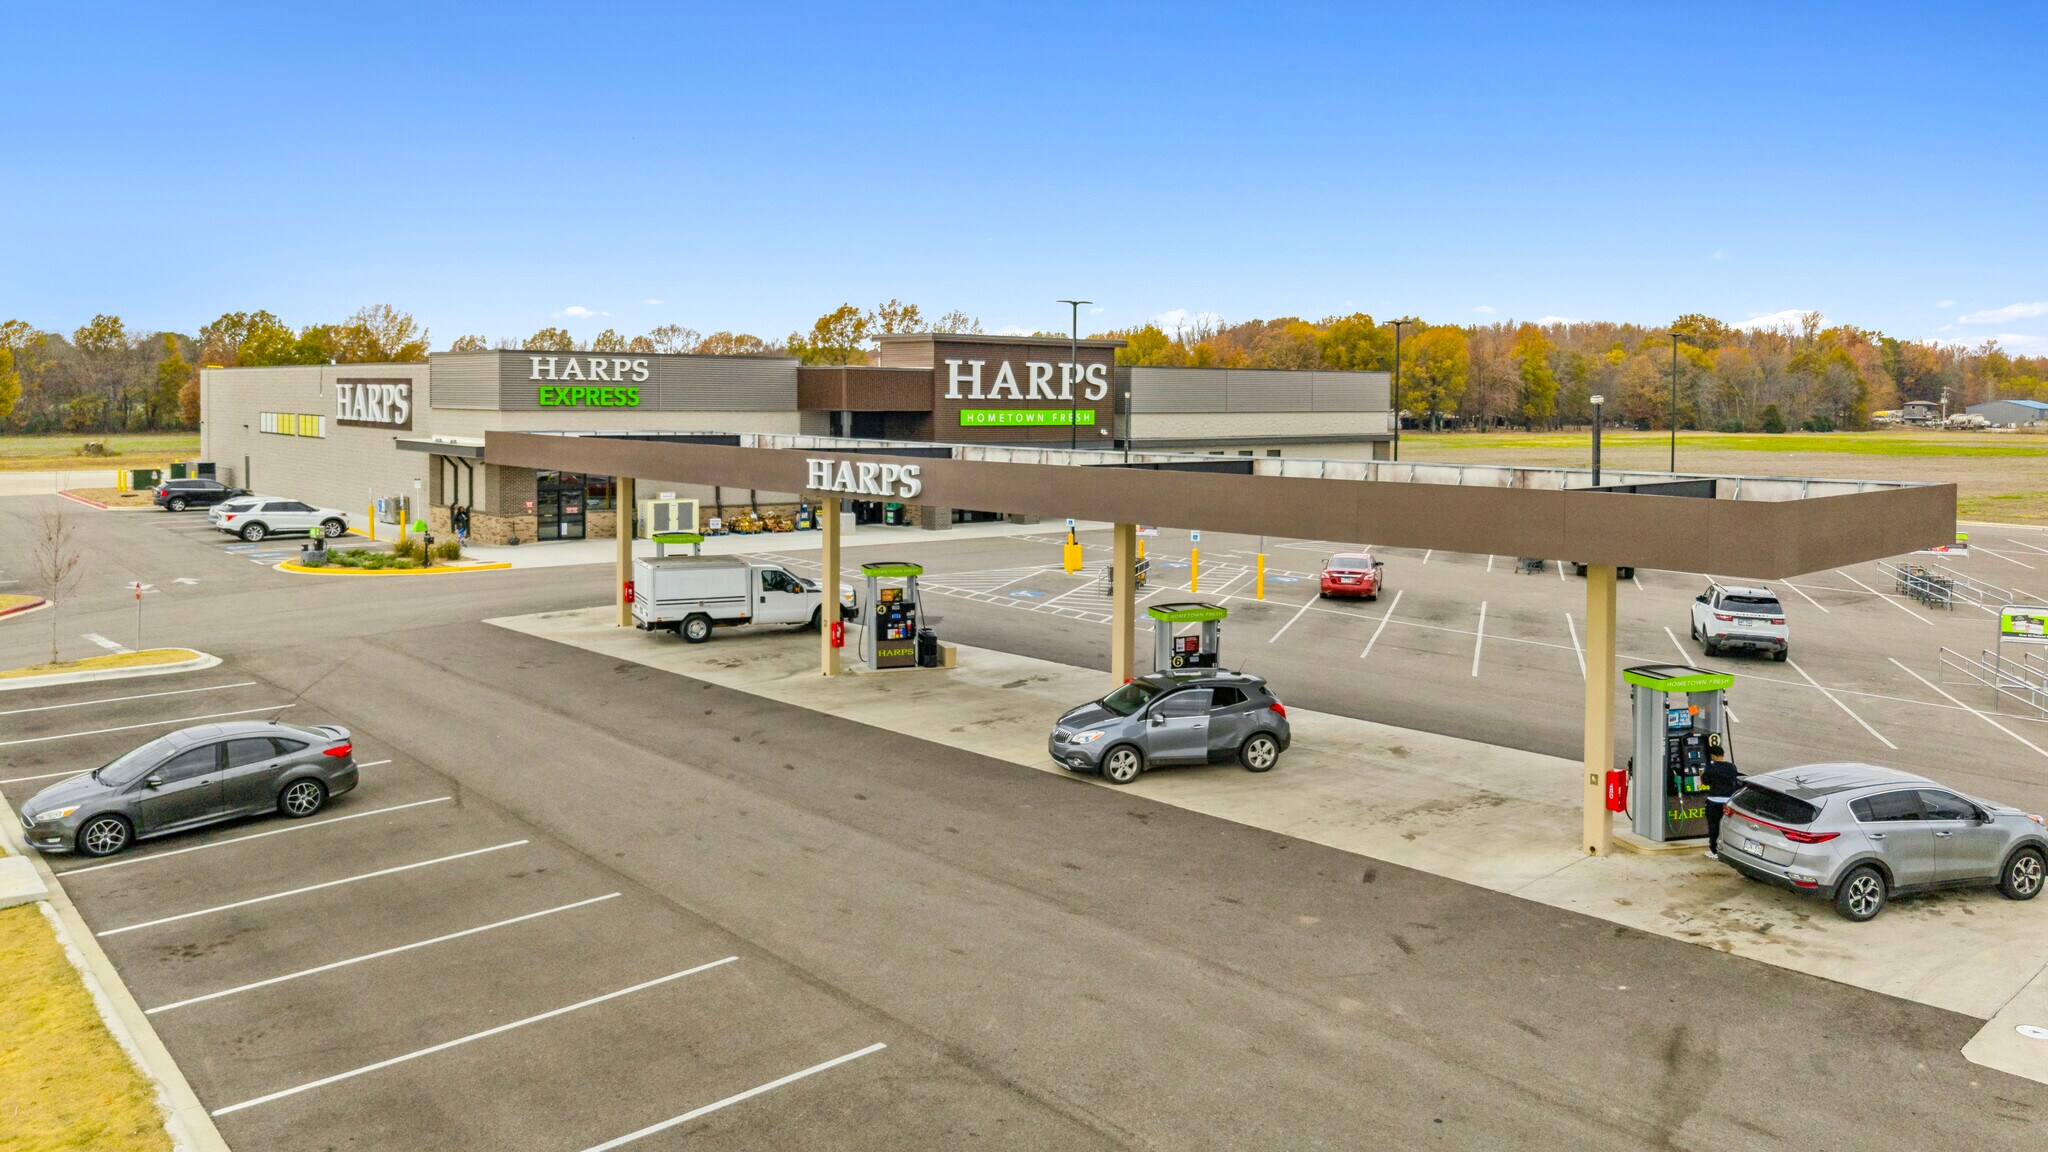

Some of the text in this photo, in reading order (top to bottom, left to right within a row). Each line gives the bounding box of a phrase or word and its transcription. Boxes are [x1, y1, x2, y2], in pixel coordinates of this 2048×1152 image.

[529, 356, 649, 382] HARPS
[944, 359, 1109, 401] HARPS
[336, 383, 410, 425] HARPS
[539, 386, 641, 407] EXPRESS
[966, 412, 1091, 423] HOMETOWN FRESH
[805, 458, 922, 498] HARPS
[878, 648, 914, 657] HARPS
[1666, 679, 1707, 687] HOMETOWN
[1668, 808, 1706, 820] HARP
